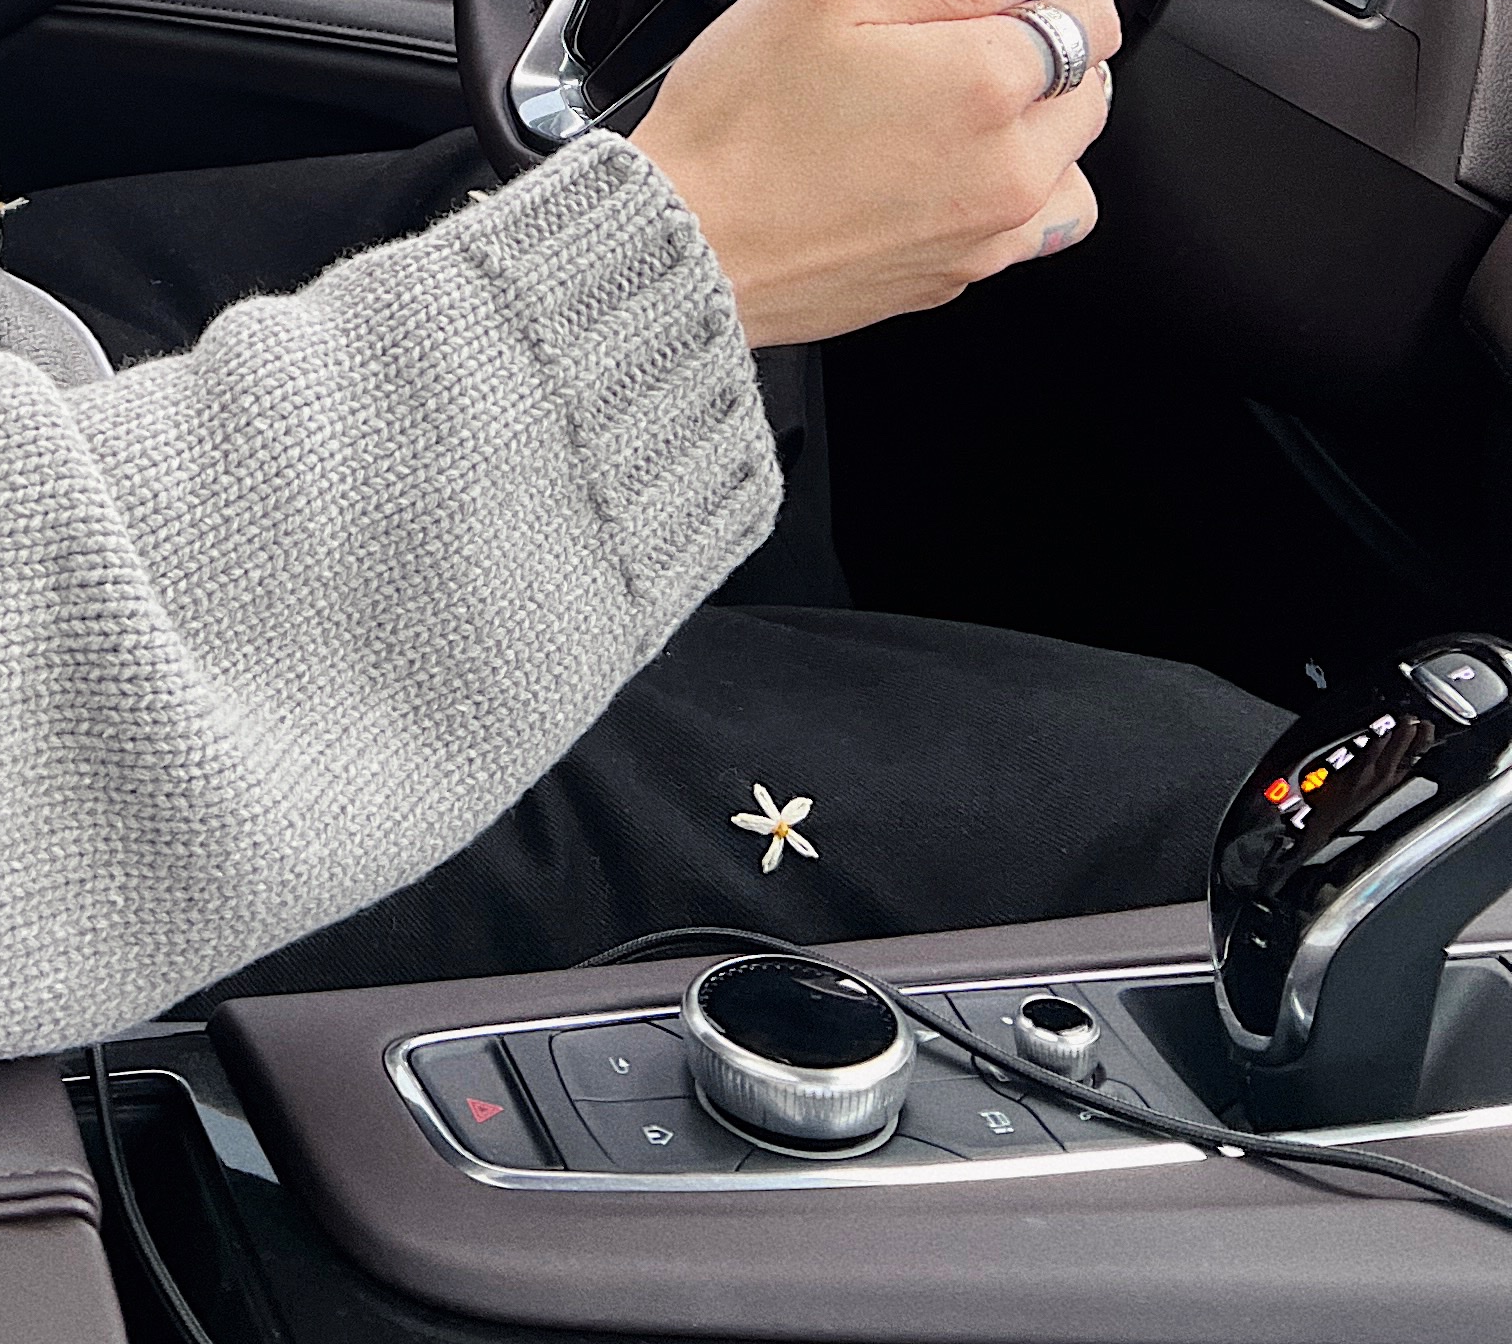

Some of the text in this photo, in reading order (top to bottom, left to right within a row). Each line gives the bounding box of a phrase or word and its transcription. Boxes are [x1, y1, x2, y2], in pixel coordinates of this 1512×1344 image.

[1448, 665, 1476, 682] P
[1369, 713, 1397, 738] R
[1326, 746, 1355, 771] N
